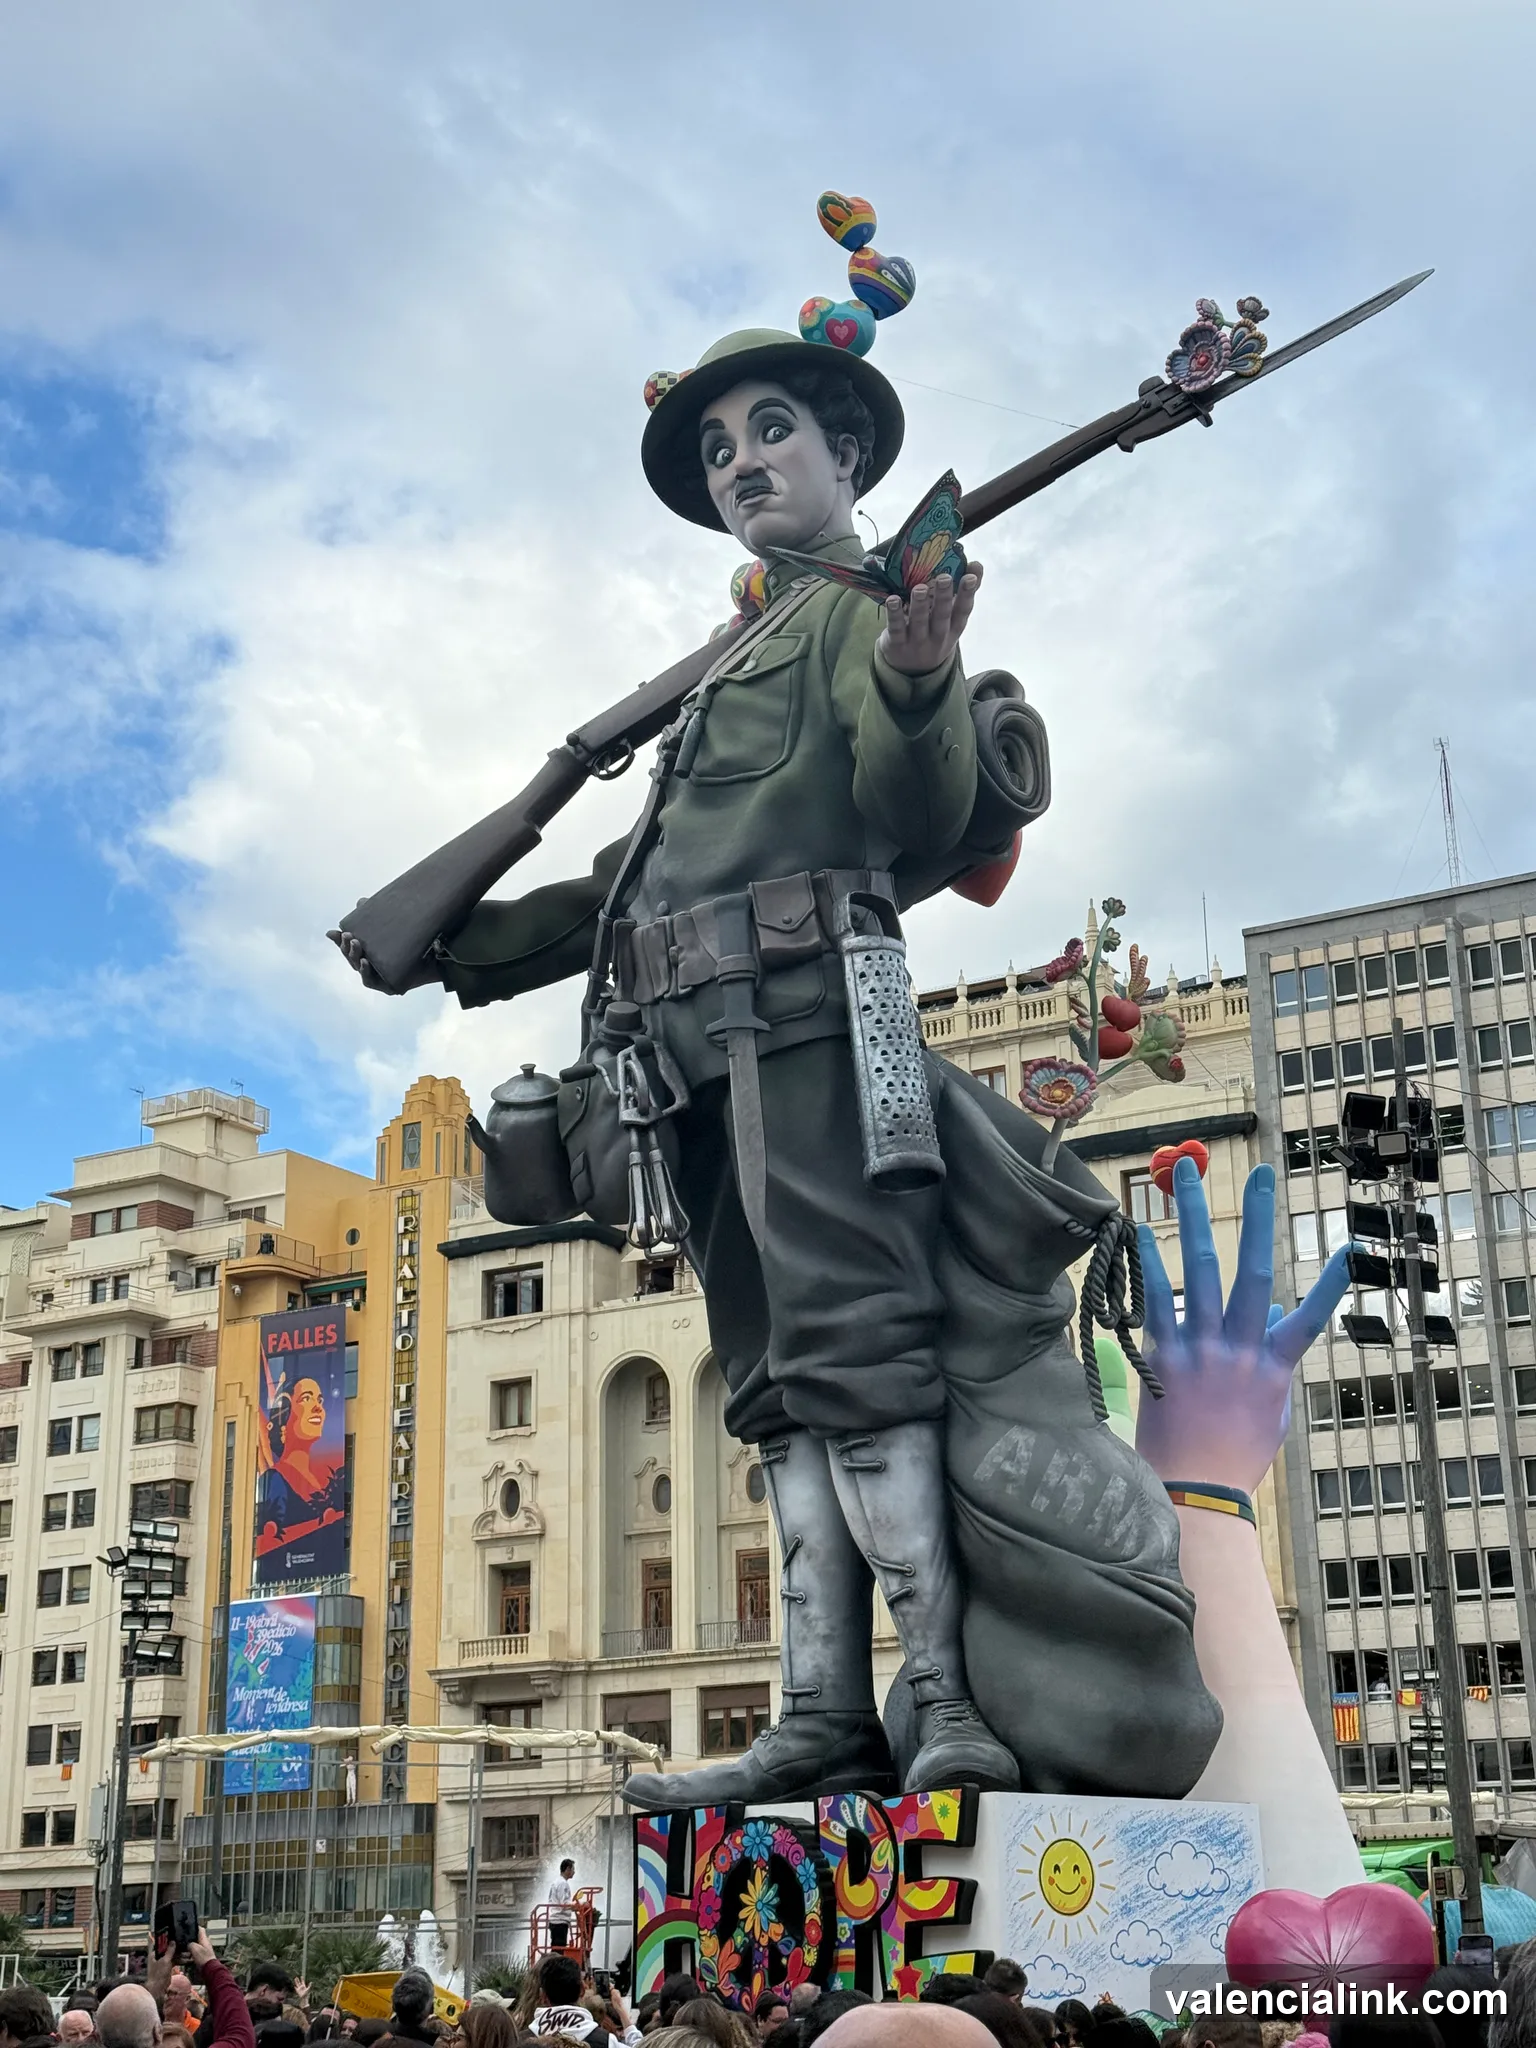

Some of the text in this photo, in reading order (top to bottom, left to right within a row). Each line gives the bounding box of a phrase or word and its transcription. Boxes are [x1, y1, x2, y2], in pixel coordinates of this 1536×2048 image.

[395, 1214, 418, 1352] RIALTO
[267, 1323, 338, 1354] FALLES
[390, 1383, 415, 1527] TEATRE
[261, 1639, 284, 1657] 2026
[232, 1685, 288, 1703] Moment de
[264, 1696, 309, 1715] tendresa
[631, 1783, 995, 2013] HOPE
